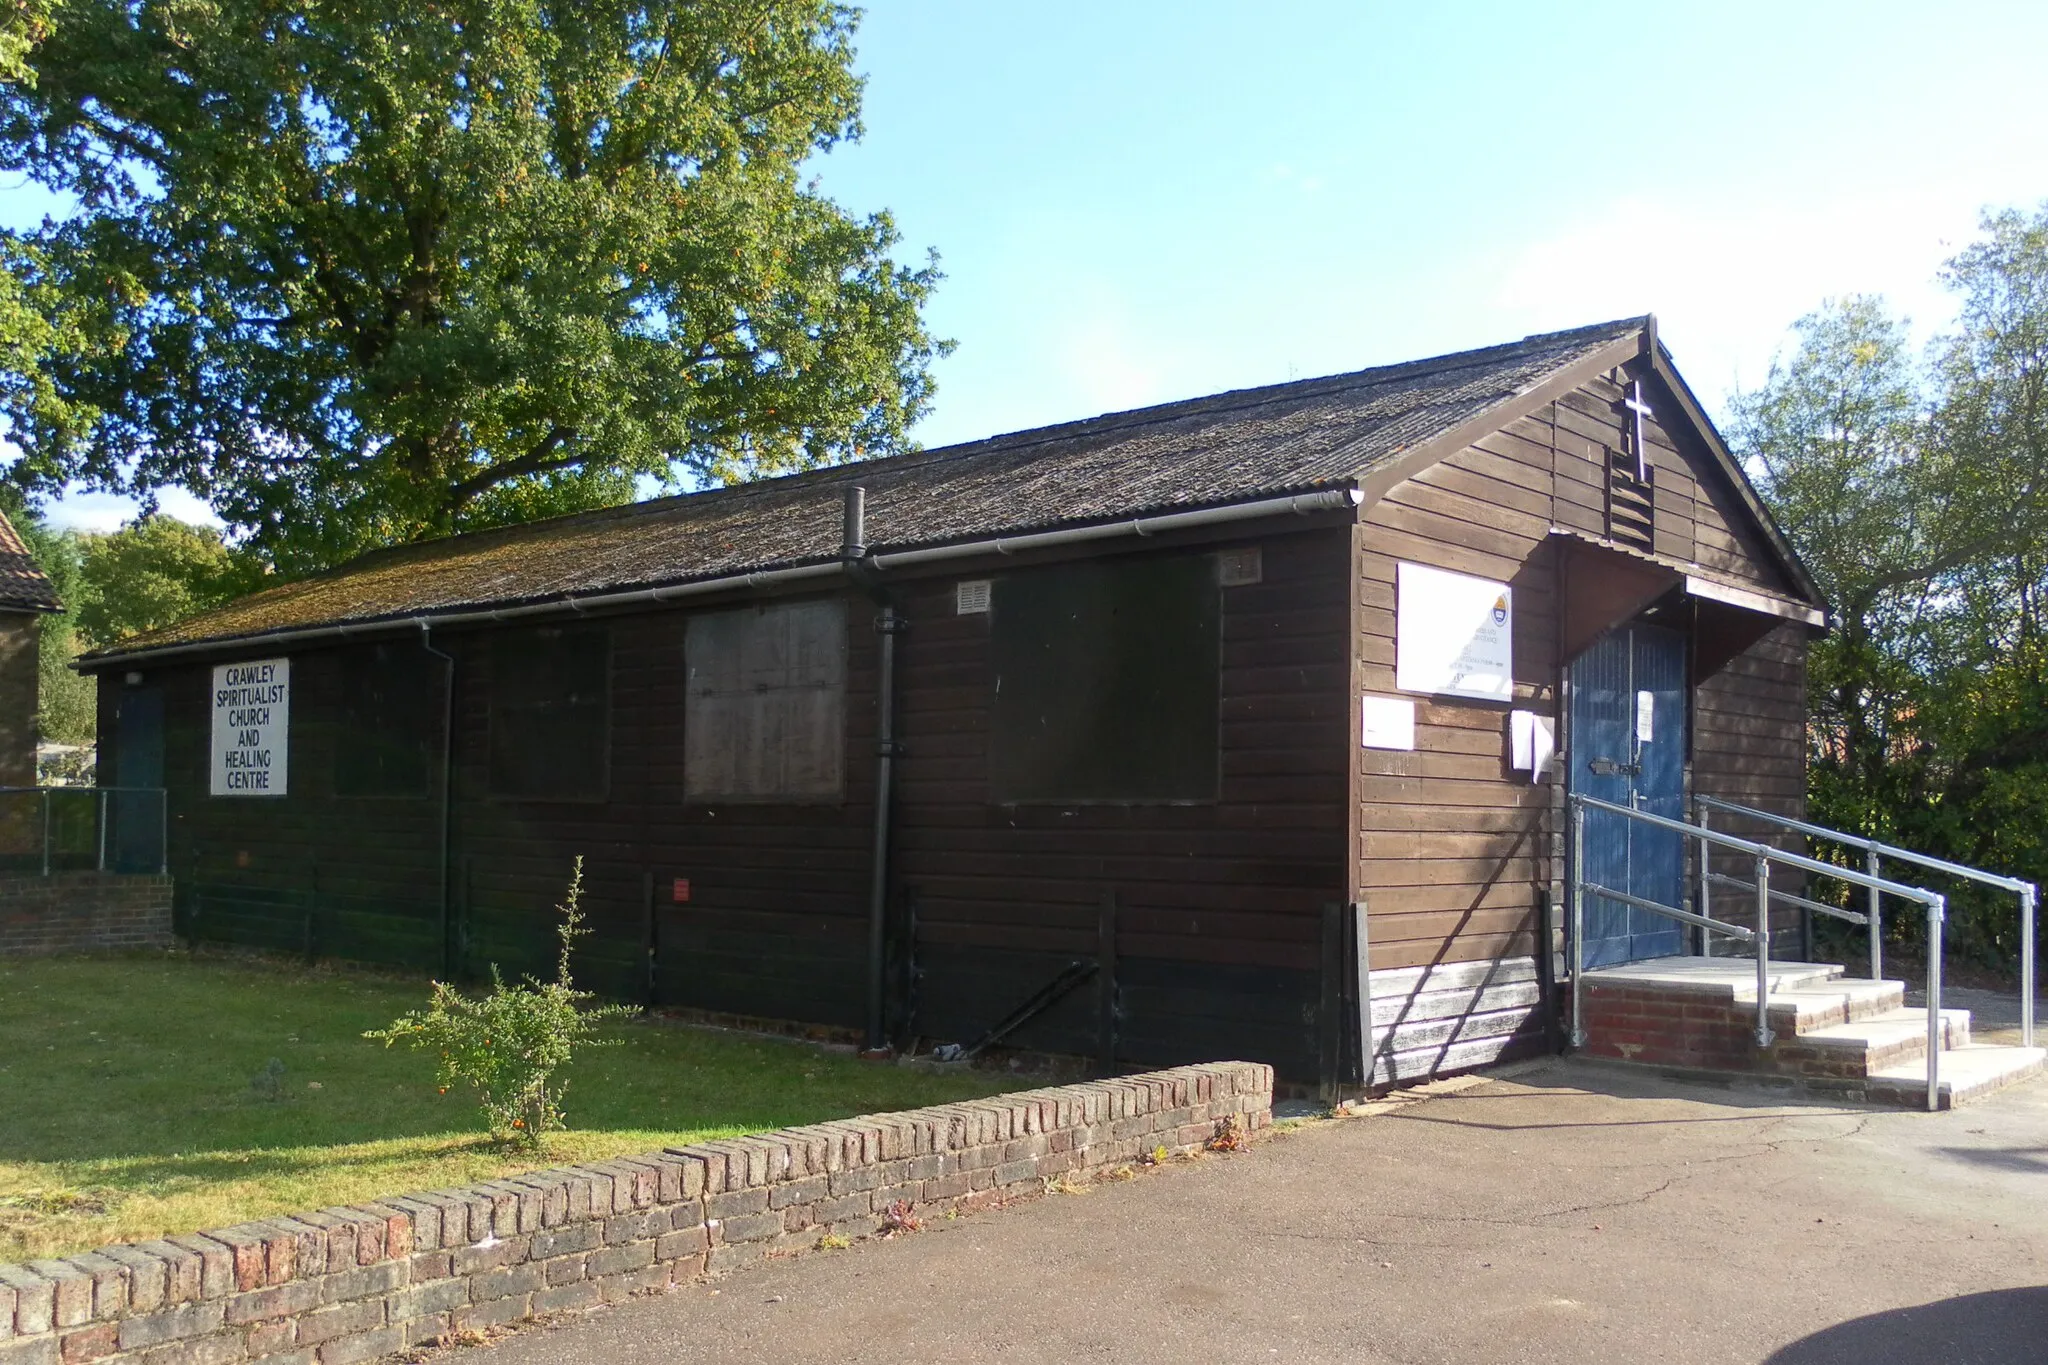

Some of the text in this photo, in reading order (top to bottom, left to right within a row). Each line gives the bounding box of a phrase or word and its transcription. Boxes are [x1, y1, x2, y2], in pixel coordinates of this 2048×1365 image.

[226, 664, 276, 686] CRAWLEY
[217, 685, 285, 707] SPIRITUALIST
[229, 707, 270, 727] CHURCH
[238, 729, 260, 747] AND
[225, 749, 271, 768] HEALING
[227, 771, 269, 789] CENTRE
